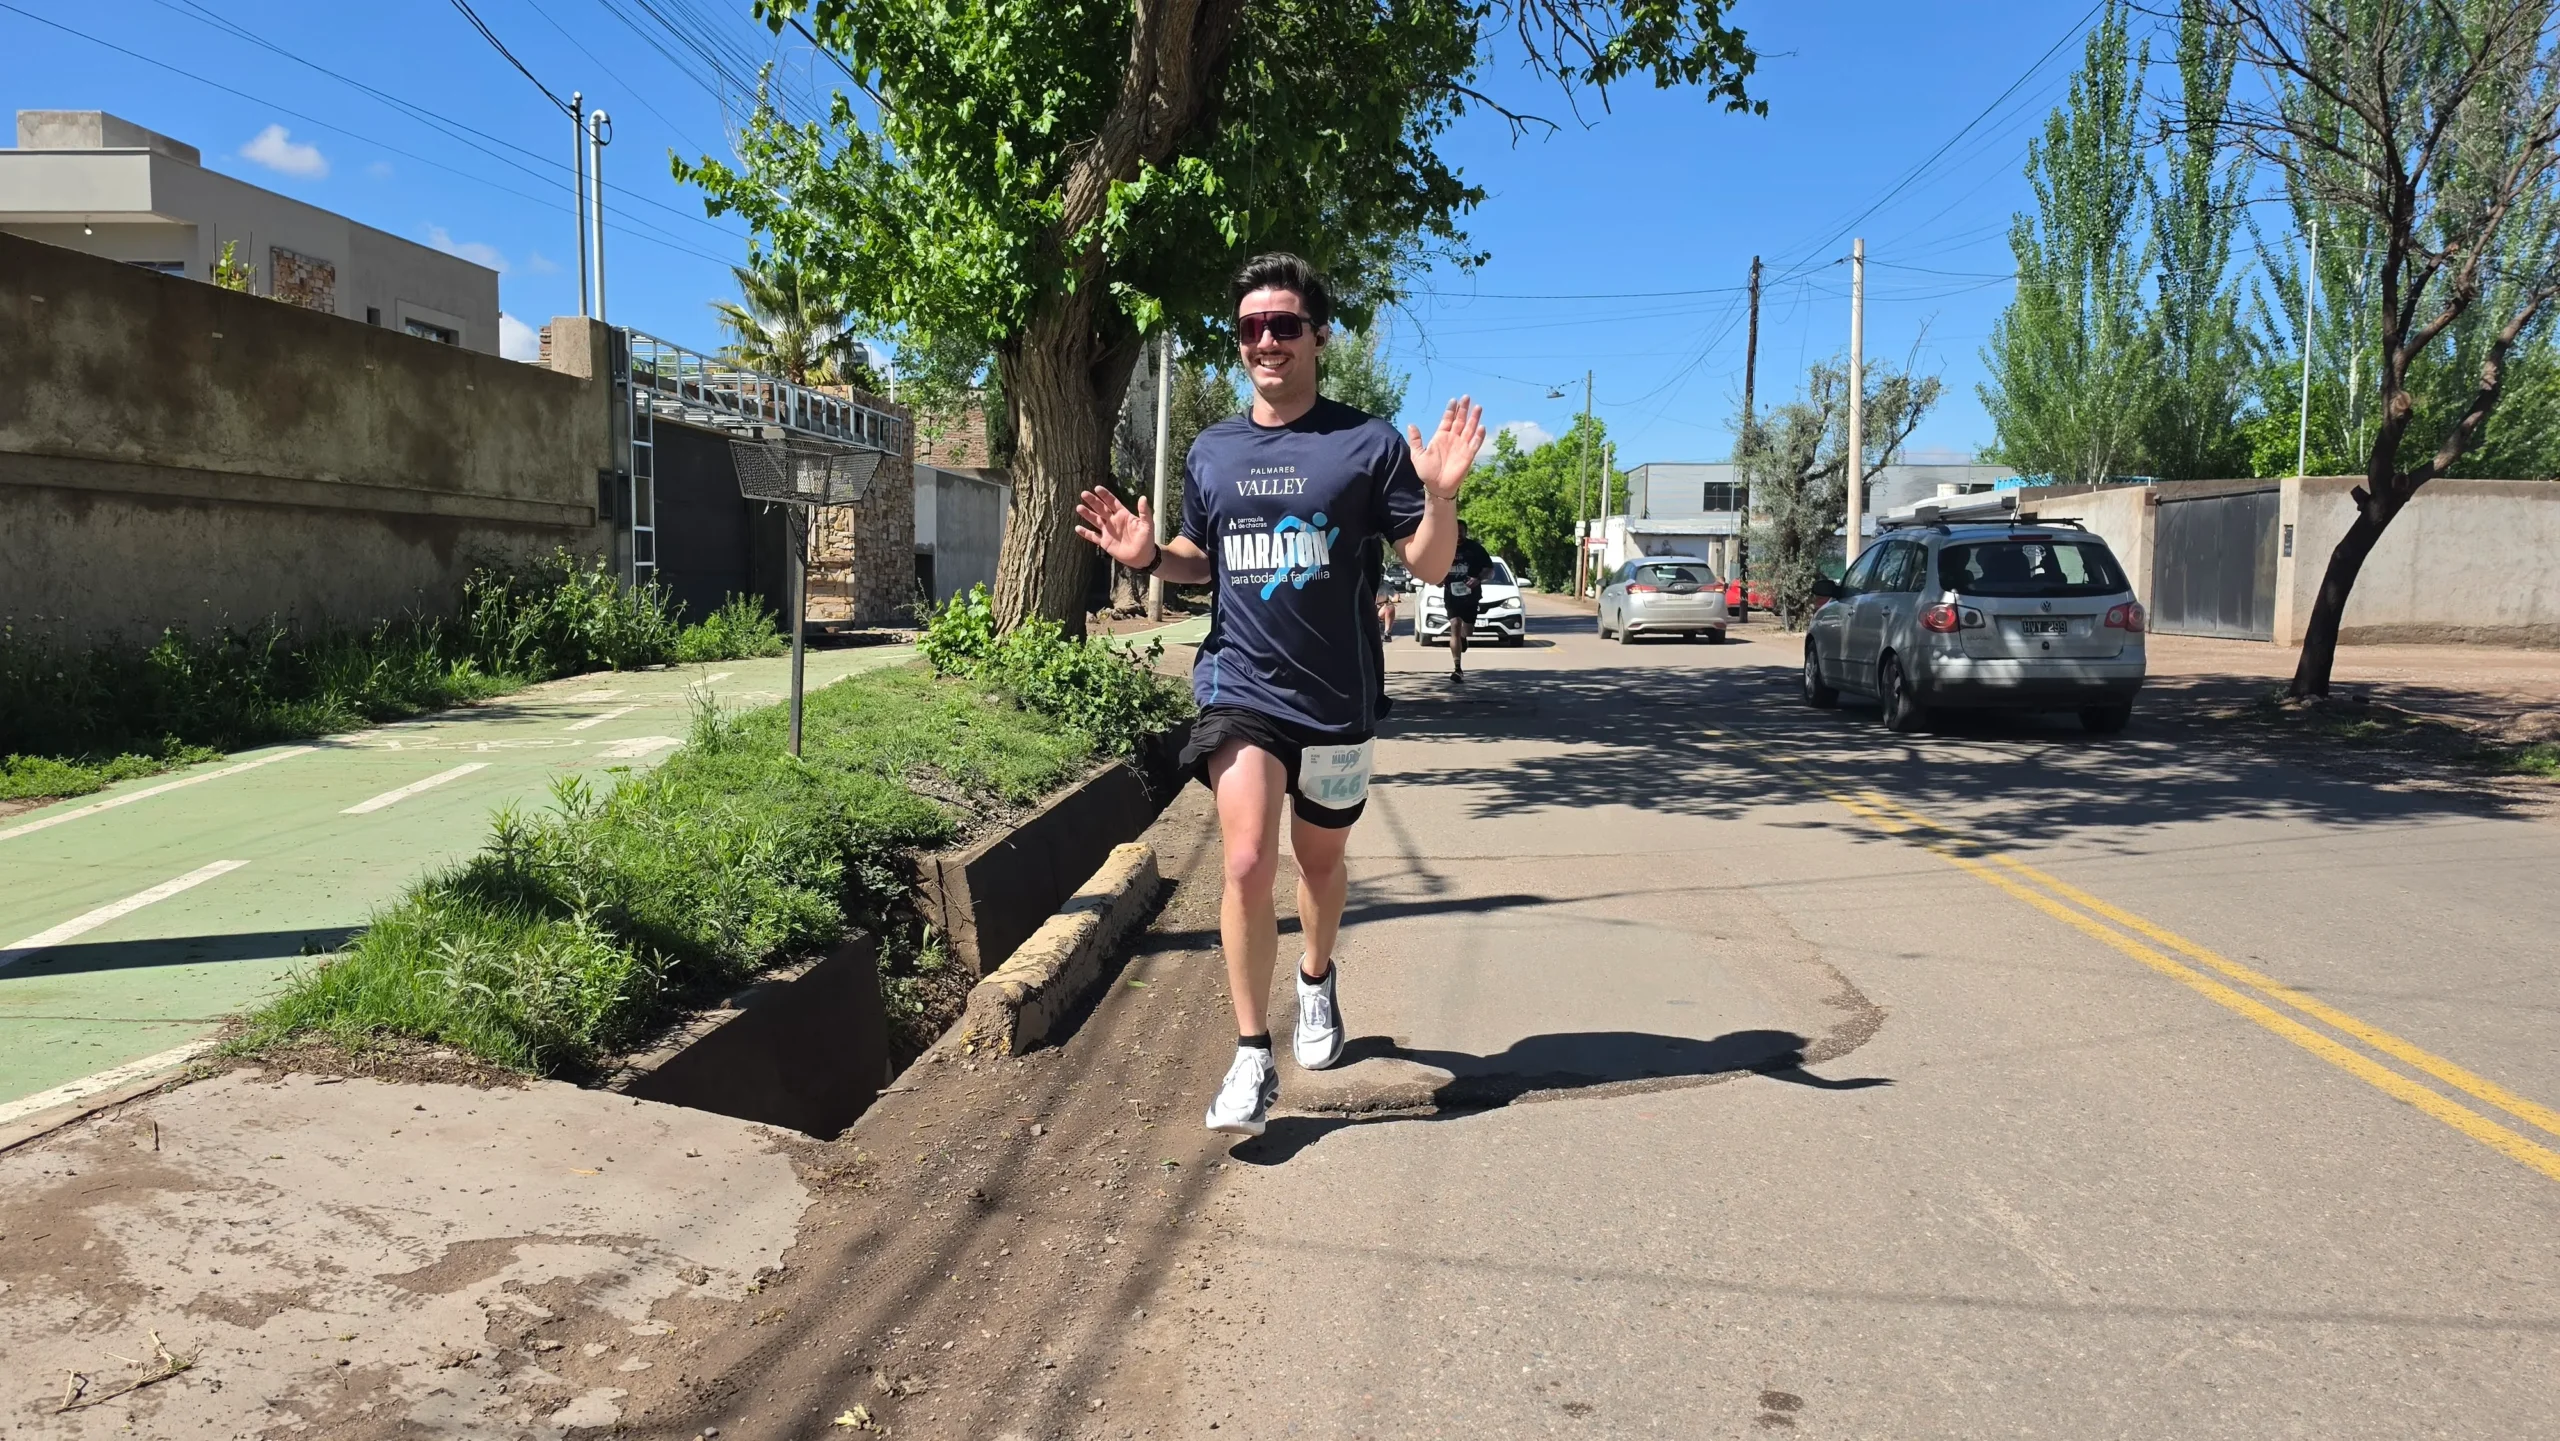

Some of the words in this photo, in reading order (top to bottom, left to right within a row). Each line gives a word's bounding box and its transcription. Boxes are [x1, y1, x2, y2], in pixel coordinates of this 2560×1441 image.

[1250, 466, 1295, 475] PALMARES
[1236, 477, 1308, 496] VALLEY
[1237, 516, 1264, 524] parroquia
[1223, 523, 1330, 571] MARATÓN
[1230, 575, 1249, 586] para
[1250, 572, 1275, 584] toda
[1278, 571, 1288, 582] la
[1290, 569, 1330, 582] familia
[2024, 621, 2041, 632] HVY
[2048, 621, 2066, 632] 299
[1321, 774, 1361, 798] 146
